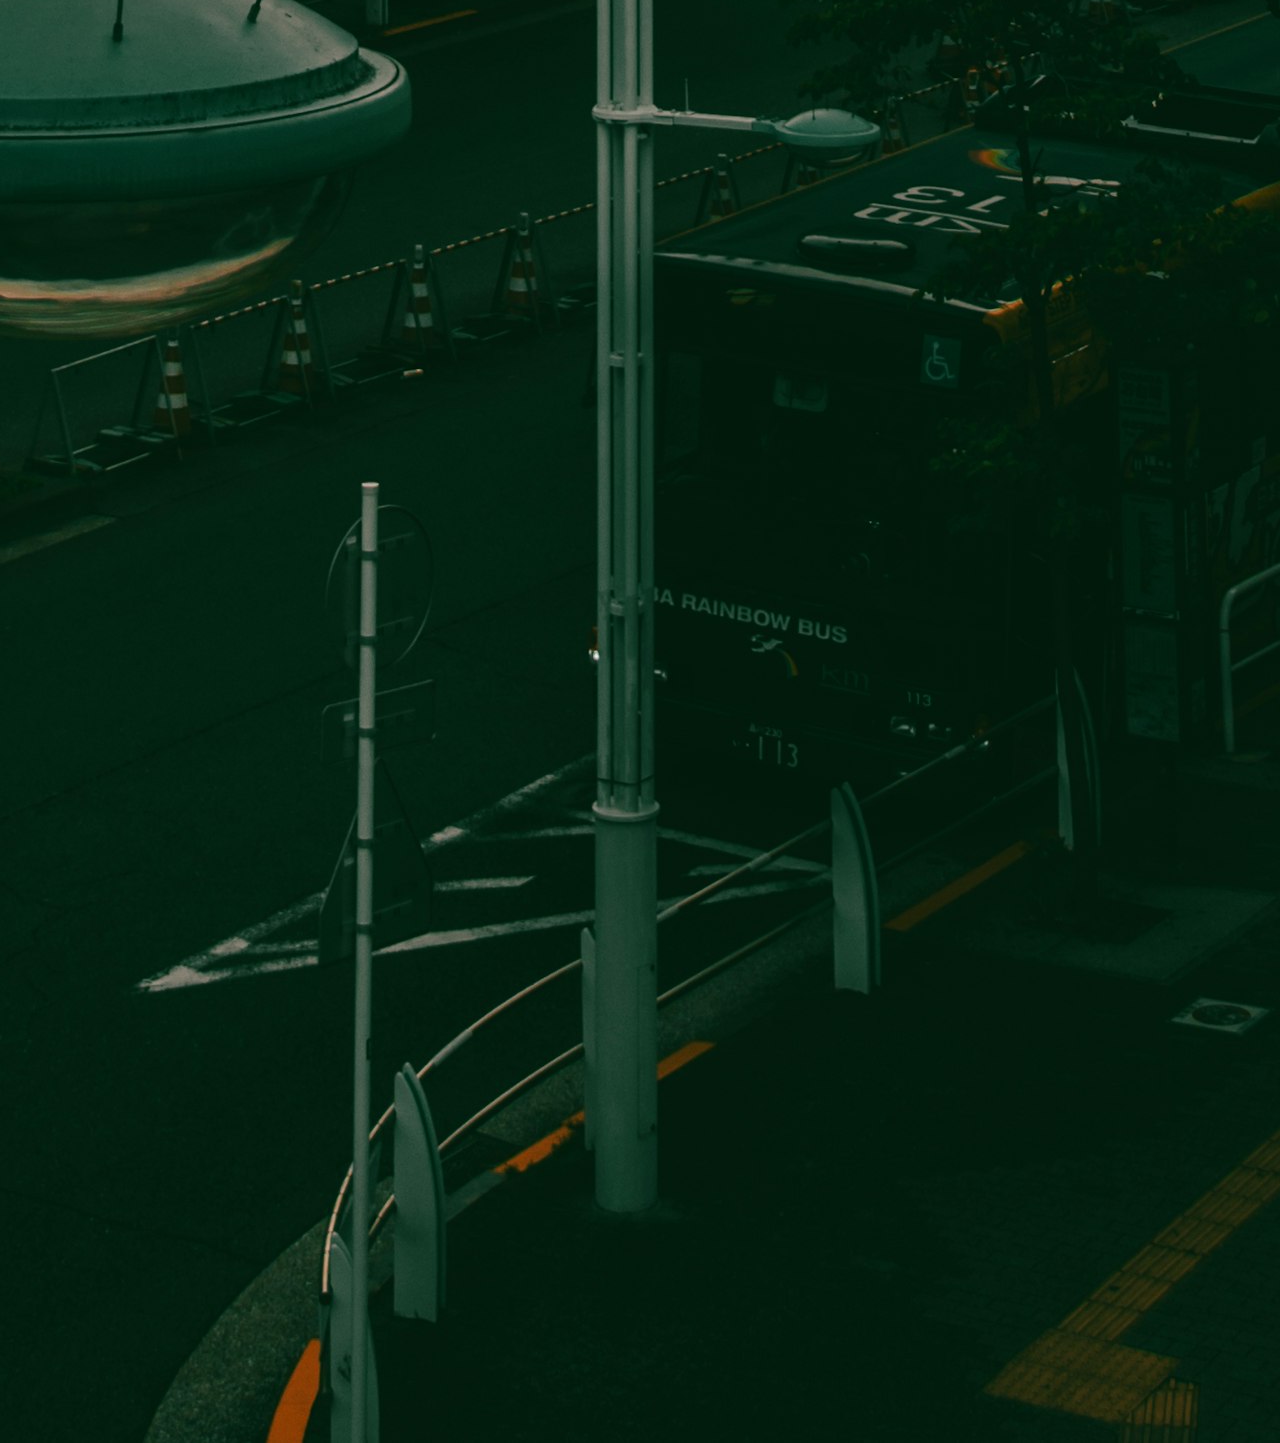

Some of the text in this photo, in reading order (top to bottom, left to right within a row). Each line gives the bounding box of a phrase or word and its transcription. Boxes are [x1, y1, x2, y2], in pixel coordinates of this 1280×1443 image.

[681, 593, 793, 632] RAINBOW
[797, 618, 849, 645] BUS
[907, 691, 934, 708] 113
